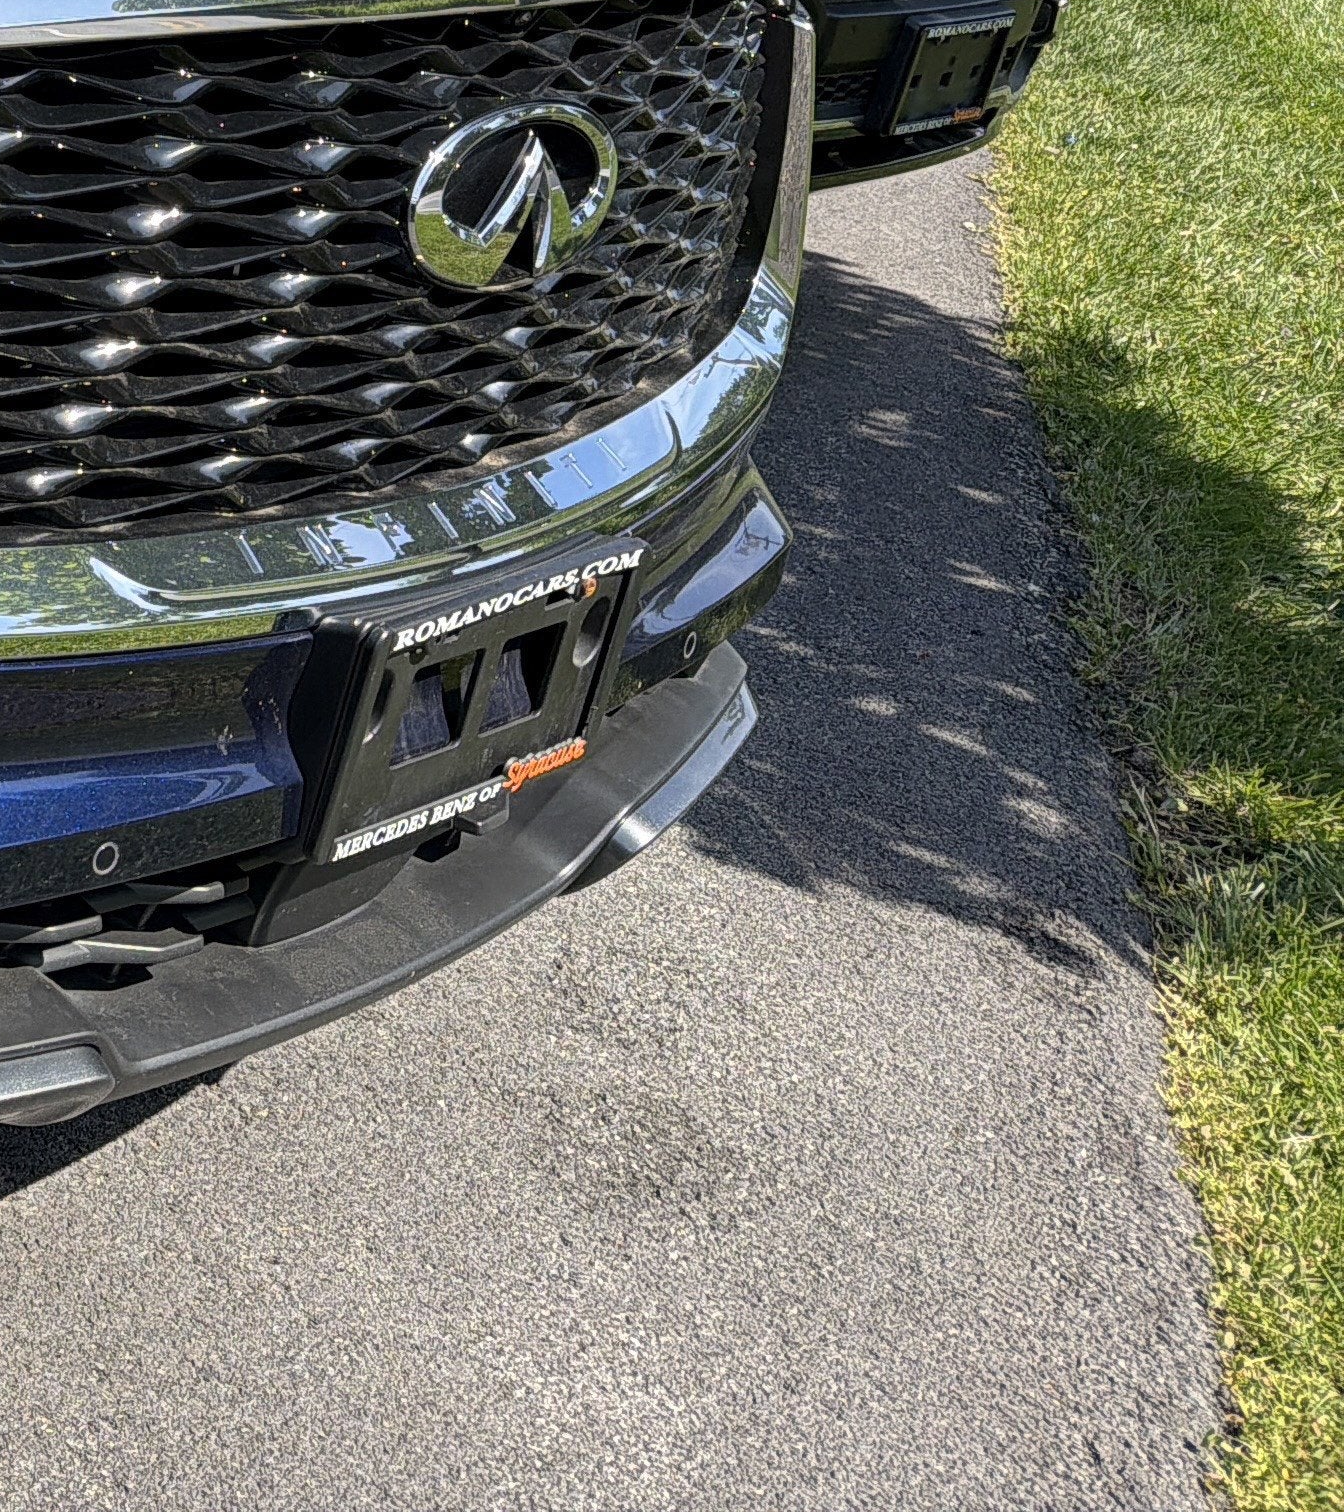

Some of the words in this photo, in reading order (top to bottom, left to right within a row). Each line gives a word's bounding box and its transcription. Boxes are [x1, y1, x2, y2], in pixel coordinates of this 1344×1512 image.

[236, 436, 629, 576] INFINITI
[392, 548, 645, 651] ROMANOCARS.COM
[503, 738, 587, 793] Syracuse
[332, 813, 430, 862] MERCEDES
[430, 791, 477, 823] BENZ
[478, 782, 502, 804] OF
